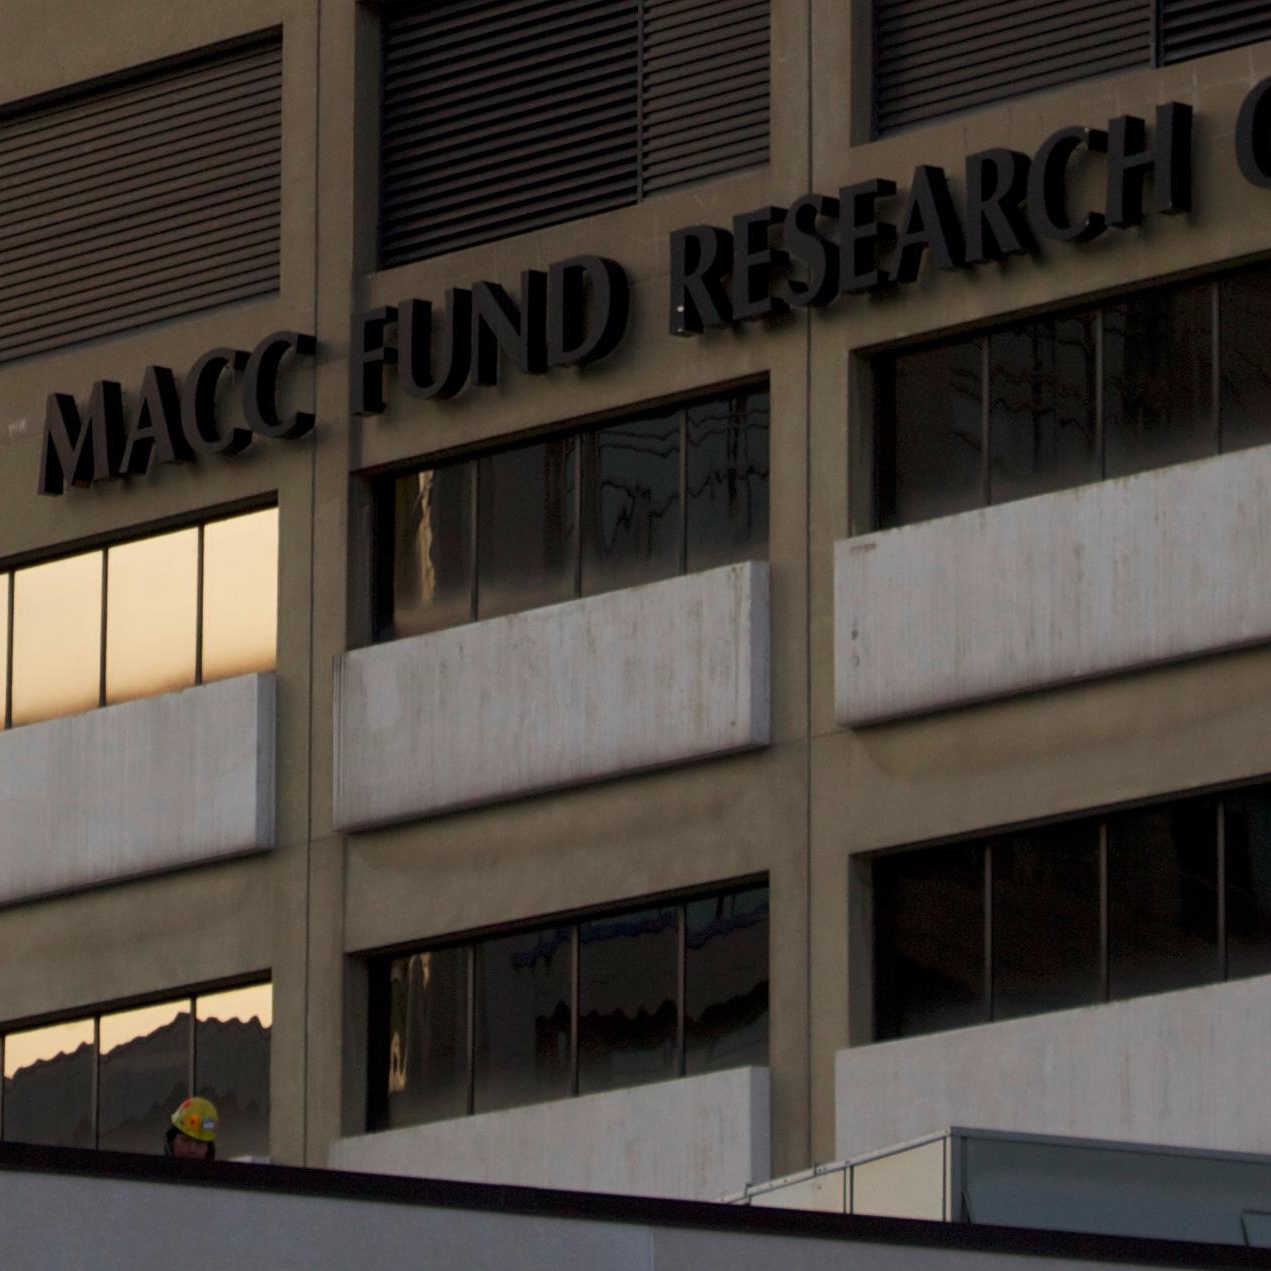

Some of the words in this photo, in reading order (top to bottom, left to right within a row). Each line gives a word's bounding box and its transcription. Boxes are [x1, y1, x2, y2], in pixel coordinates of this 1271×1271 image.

[37, 331, 318, 496] MACC
[354, 254, 631, 416] FUND
[669, 101, 1194, 337] RESEARCH
